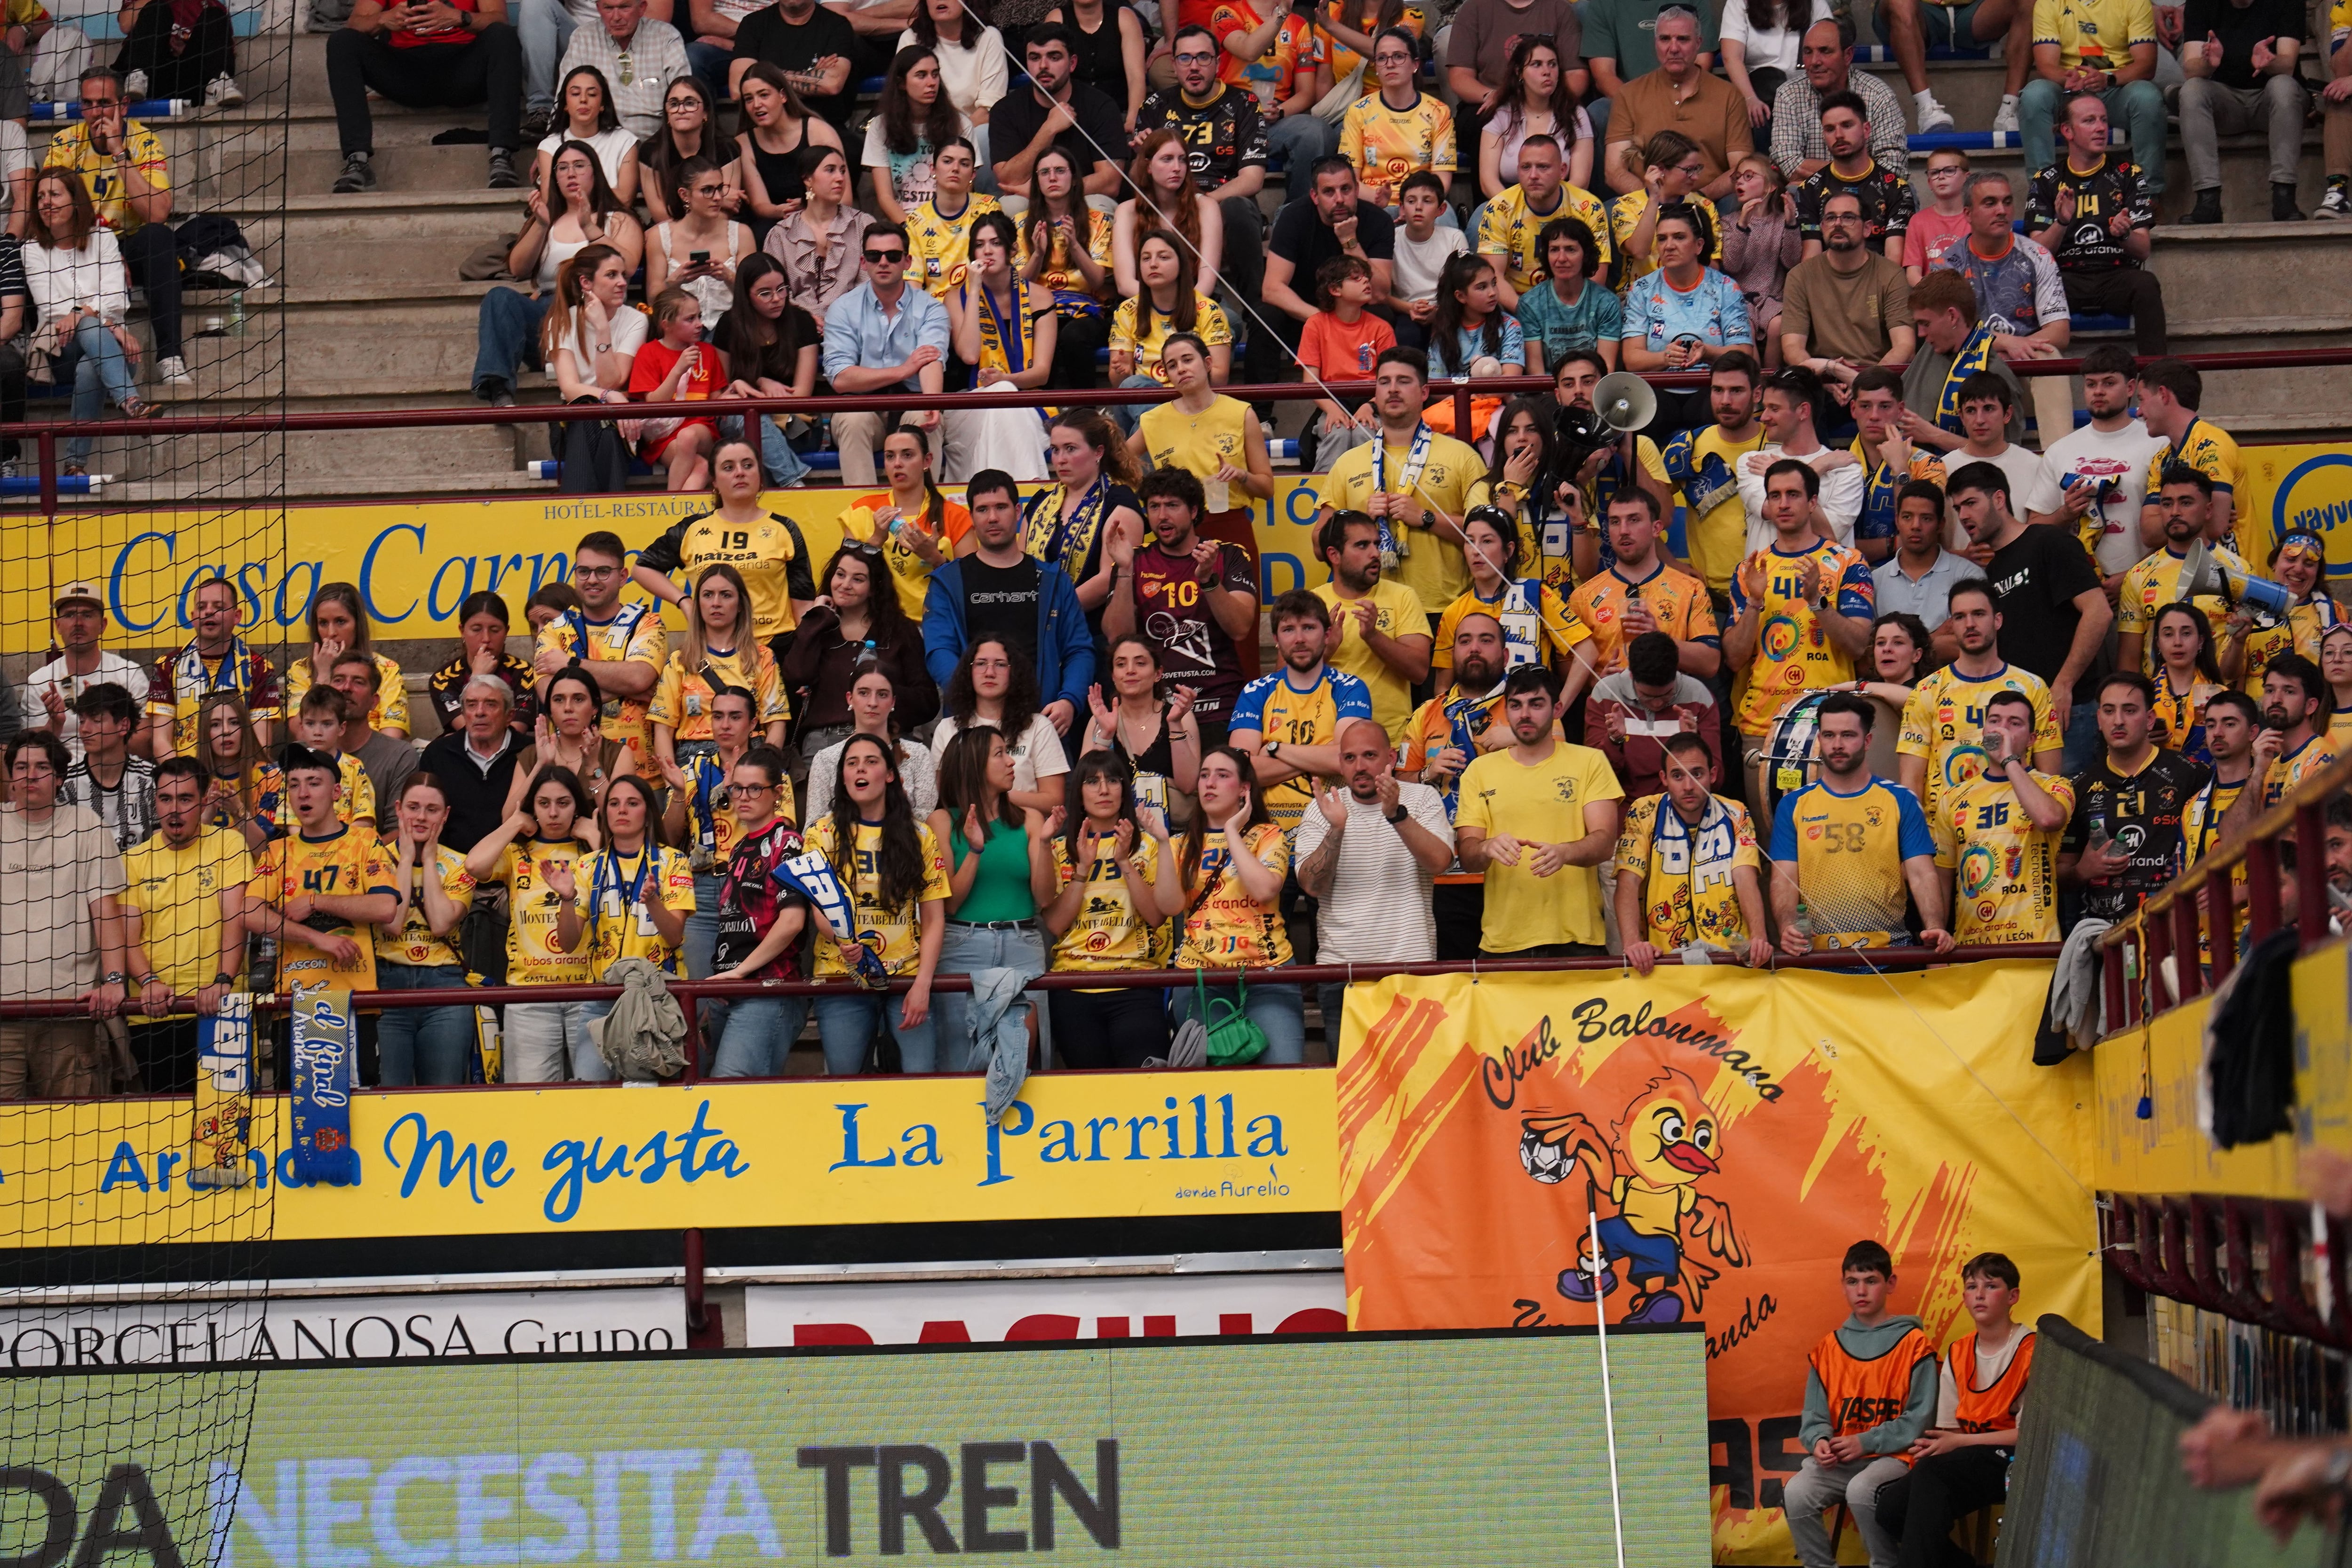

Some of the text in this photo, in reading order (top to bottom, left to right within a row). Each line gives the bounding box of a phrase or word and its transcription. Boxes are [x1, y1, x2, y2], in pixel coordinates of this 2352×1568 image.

[1216, 146, 1236, 155] GS
[2077, 195, 2099, 218] 14
[544, 501, 712, 519] HOTEL-RESTAURA
[721, 531, 749, 549] 19
[694, 548, 758, 563] haizea
[694, 559, 771, 575] tecranda
[1141, 571, 1167, 580] hummel
[109, 532, 323, 631] Casa
[970, 590, 1039, 604] carhart
[1161, 581, 1199, 608] 10
[1807, 653, 1829, 661] ROA
[1161, 669, 1216, 679] OSVETUSTA.COM
[1802, 813, 1829, 822] hummel
[1977, 805, 2008, 829] 36
[1825, 822, 1866, 853] 58
[733, 856, 748, 882] 4
[302, 865, 339, 893] 47
[671, 876, 693, 884] Pascu
[2002, 884, 2027, 895] ROA
[519, 909, 560, 925] MONTEA
[856, 914, 908, 926] TEABELLÓ
[1985, 921, 2018, 932] aranda
[1220, 936, 1249, 954] JJG
[1253, 913, 1269, 968] tecnoarand
[2006, 930, 2034, 942] LEÓN
[523, 954, 588, 966] tubos arand
[524, 975, 562, 983] CASTILLA
[294, 1010, 312, 1070] Aranda
[304, 1001, 348, 1107] el final
[1483, 997, 1785, 1110] Club Balonmano
[829, 1092, 1288, 1187] La Parrilla
[384, 1112, 516, 1204] Me
[543, 1099, 750, 1223] gusta
[1175, 1171, 1290, 1199] donde Aurelio
[1706, 1292, 1777, 1361] anda
[0, 1313, 474, 1367] ORCELANOSA
[1834, 1396, 1900, 1433] JASPE
[210, 1446, 785, 1568] NECESITA
[796, 1439, 1121, 1557] TREN
